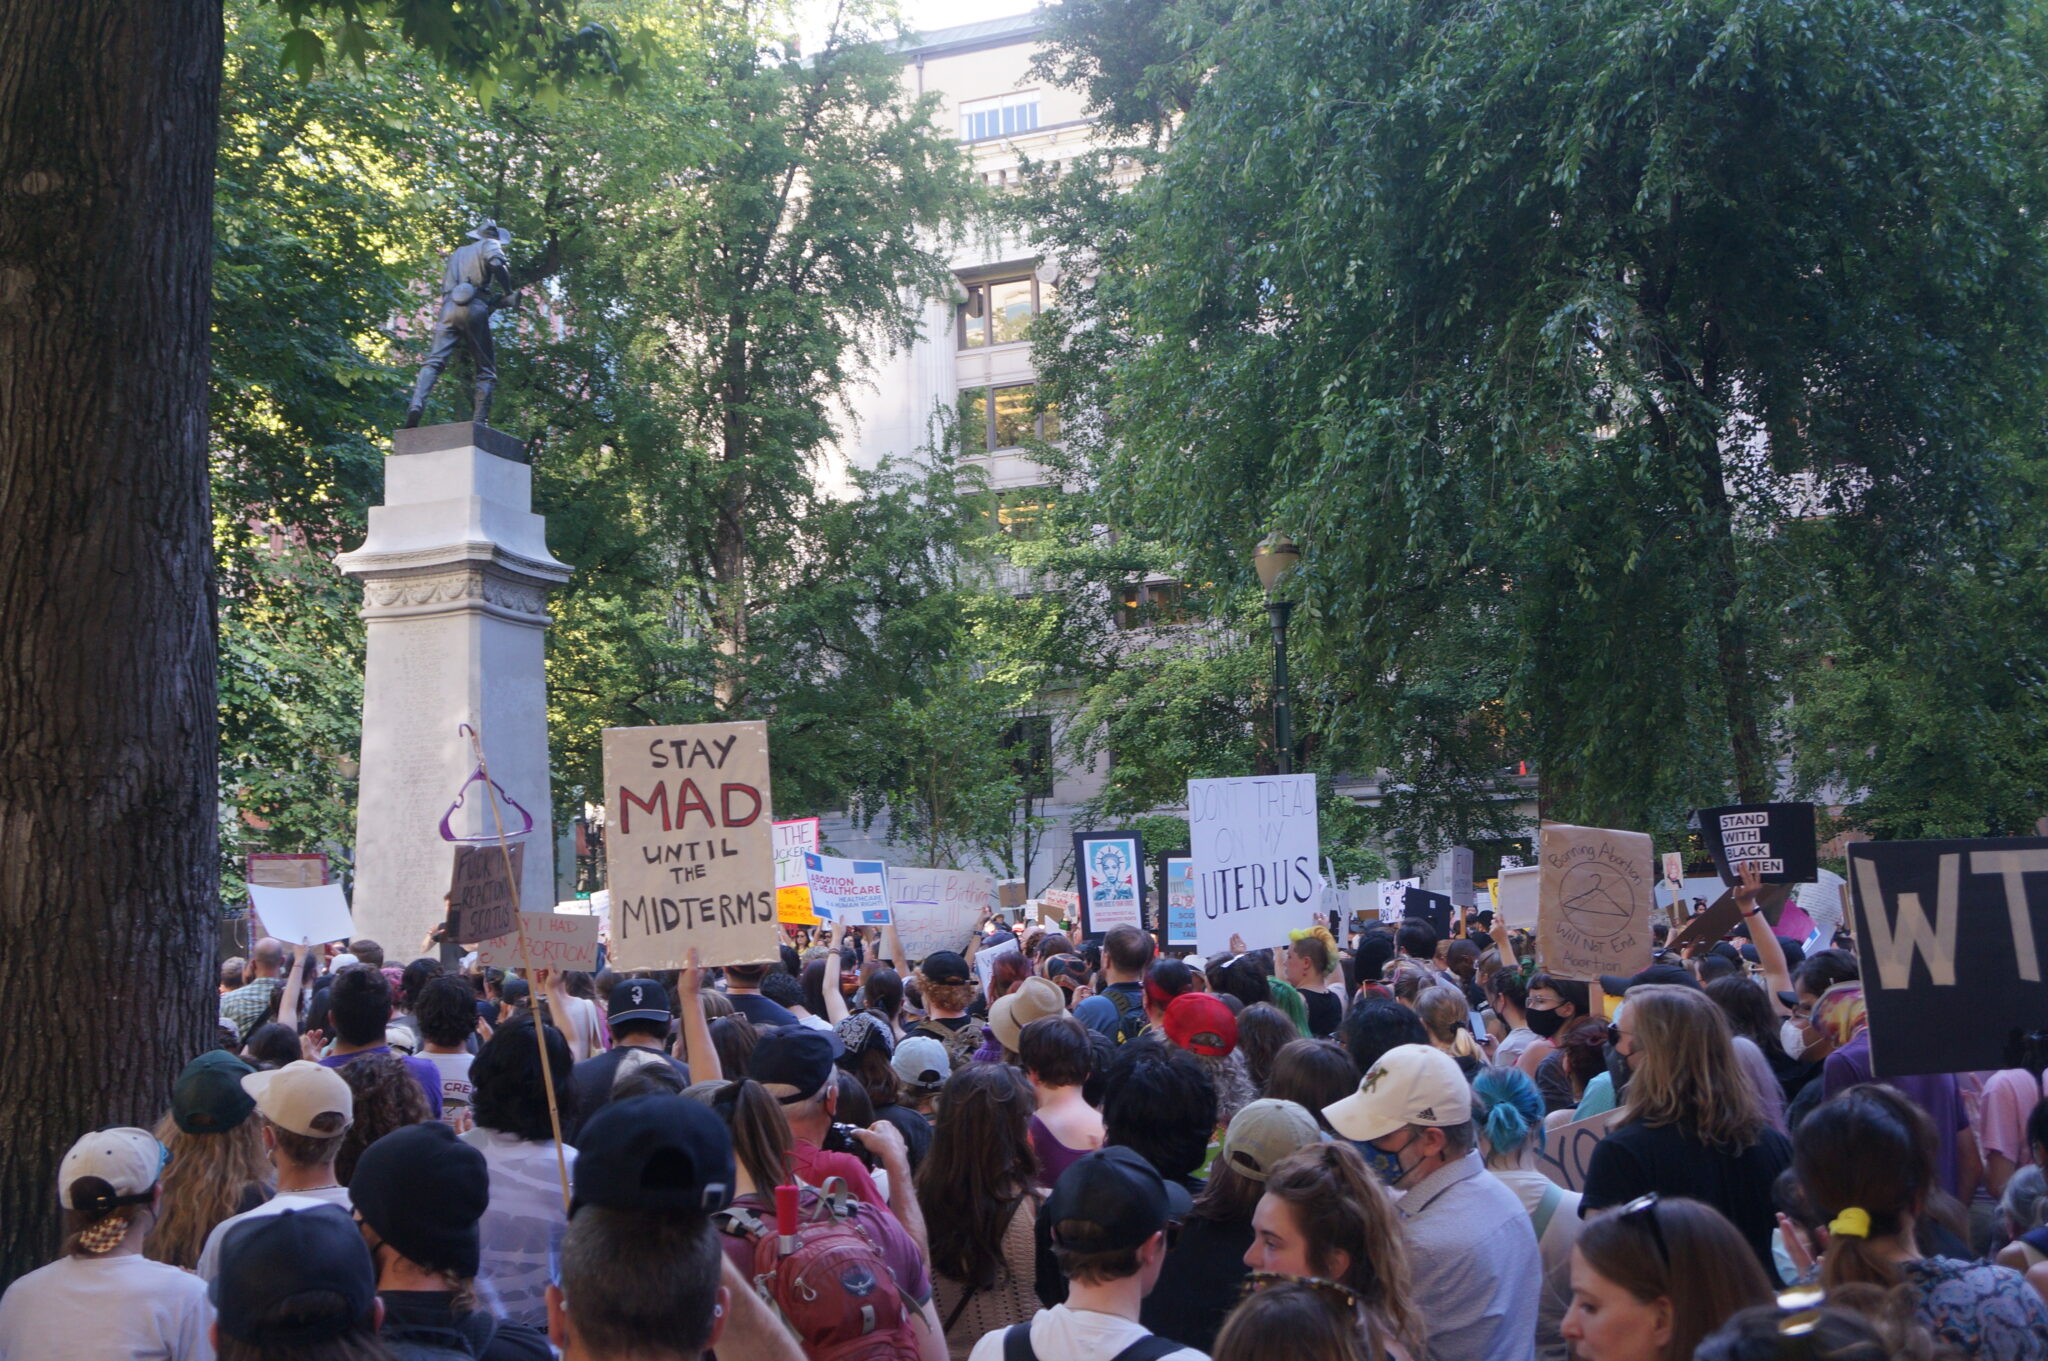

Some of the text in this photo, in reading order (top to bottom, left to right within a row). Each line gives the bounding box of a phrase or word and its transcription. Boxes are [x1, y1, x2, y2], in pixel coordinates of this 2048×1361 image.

[650, 735, 737, 769] STAY
[619, 777, 762, 834] MAD
[1252, 779, 1315, 819] TREAD
[1722, 814, 1766, 828] STAND
[779, 823, 812, 846] THE
[1214, 827, 1245, 864] ON
[1723, 830, 1757, 844] WITH
[643, 838, 738, 865] UNTIL
[1726, 845, 1767, 859] BLACK
[670, 864, 707, 884] THE
[1598, 842, 1642, 887] Abortion
[1730, 861, 1780, 875] WMEN
[811, 874, 854, 887] ABORTION
[819, 884, 881, 896] HEALTHCARE
[889, 876, 939, 901] Trust
[1201, 856, 1313, 920] UTERUS
[550, 919, 578, 933] HAD
[622, 891, 773, 939] MIDTERMS
[510, 936, 596, 963] ABORTION!
[1556, 922, 1581, 945] Will
[1610, 933, 1636, 954] End
[1562, 950, 1622, 973] Abortion
